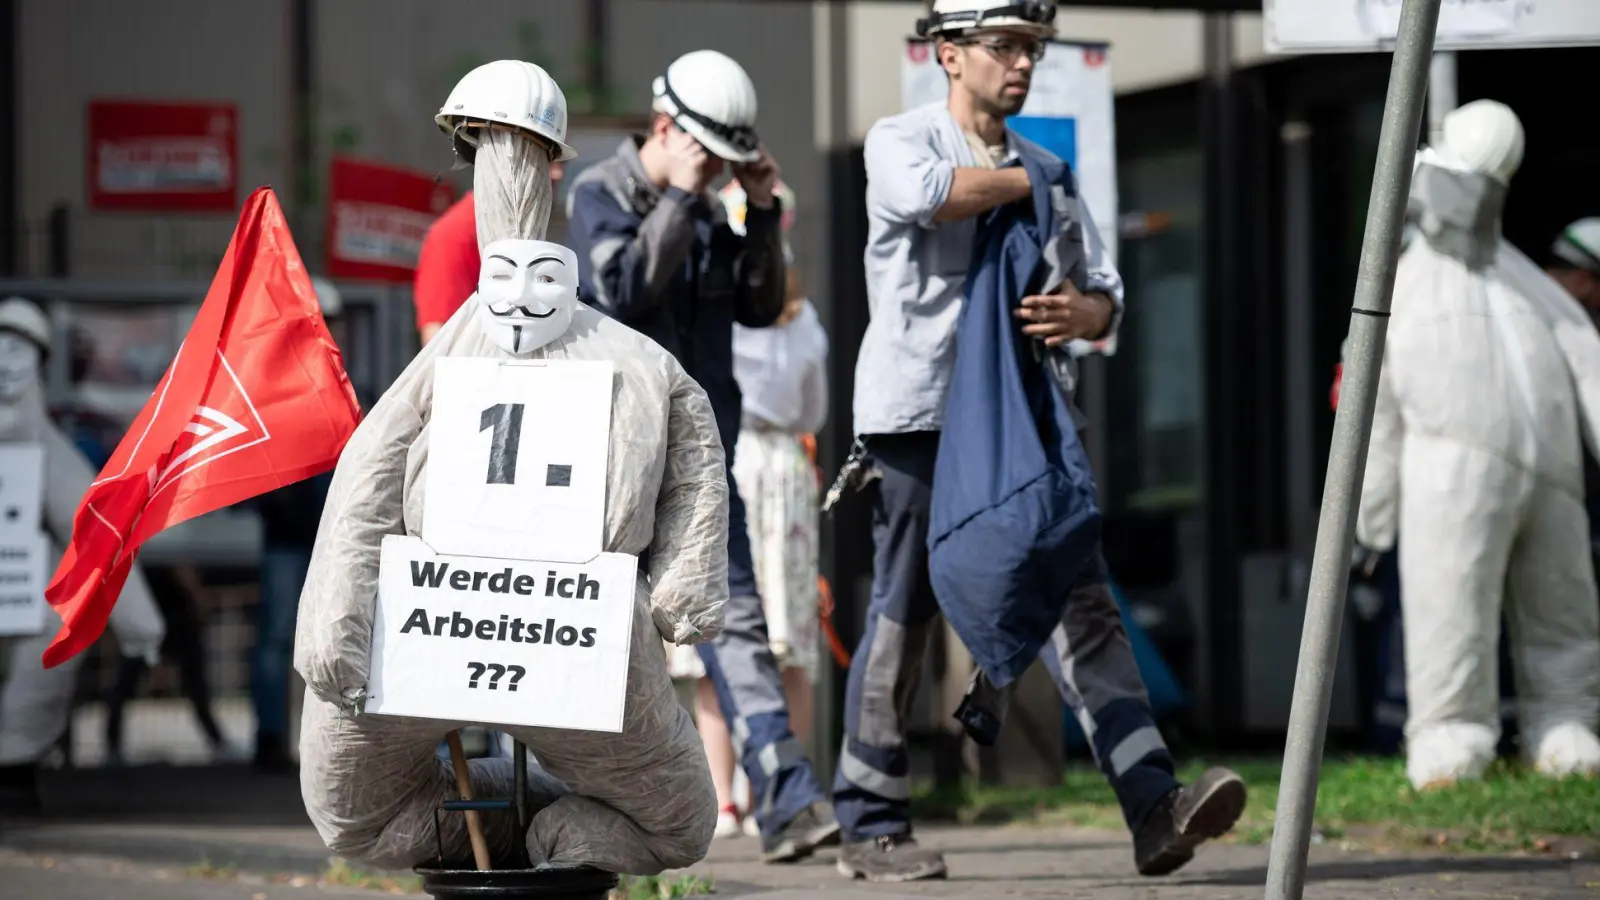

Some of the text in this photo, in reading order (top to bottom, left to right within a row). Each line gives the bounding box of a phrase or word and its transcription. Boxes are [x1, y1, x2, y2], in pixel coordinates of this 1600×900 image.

[479, 402, 573, 487] 1.
[410, 560, 600, 600] Werde ich
[399, 608, 597, 648] Arbeitslos
[466, 661, 527, 692] ???
